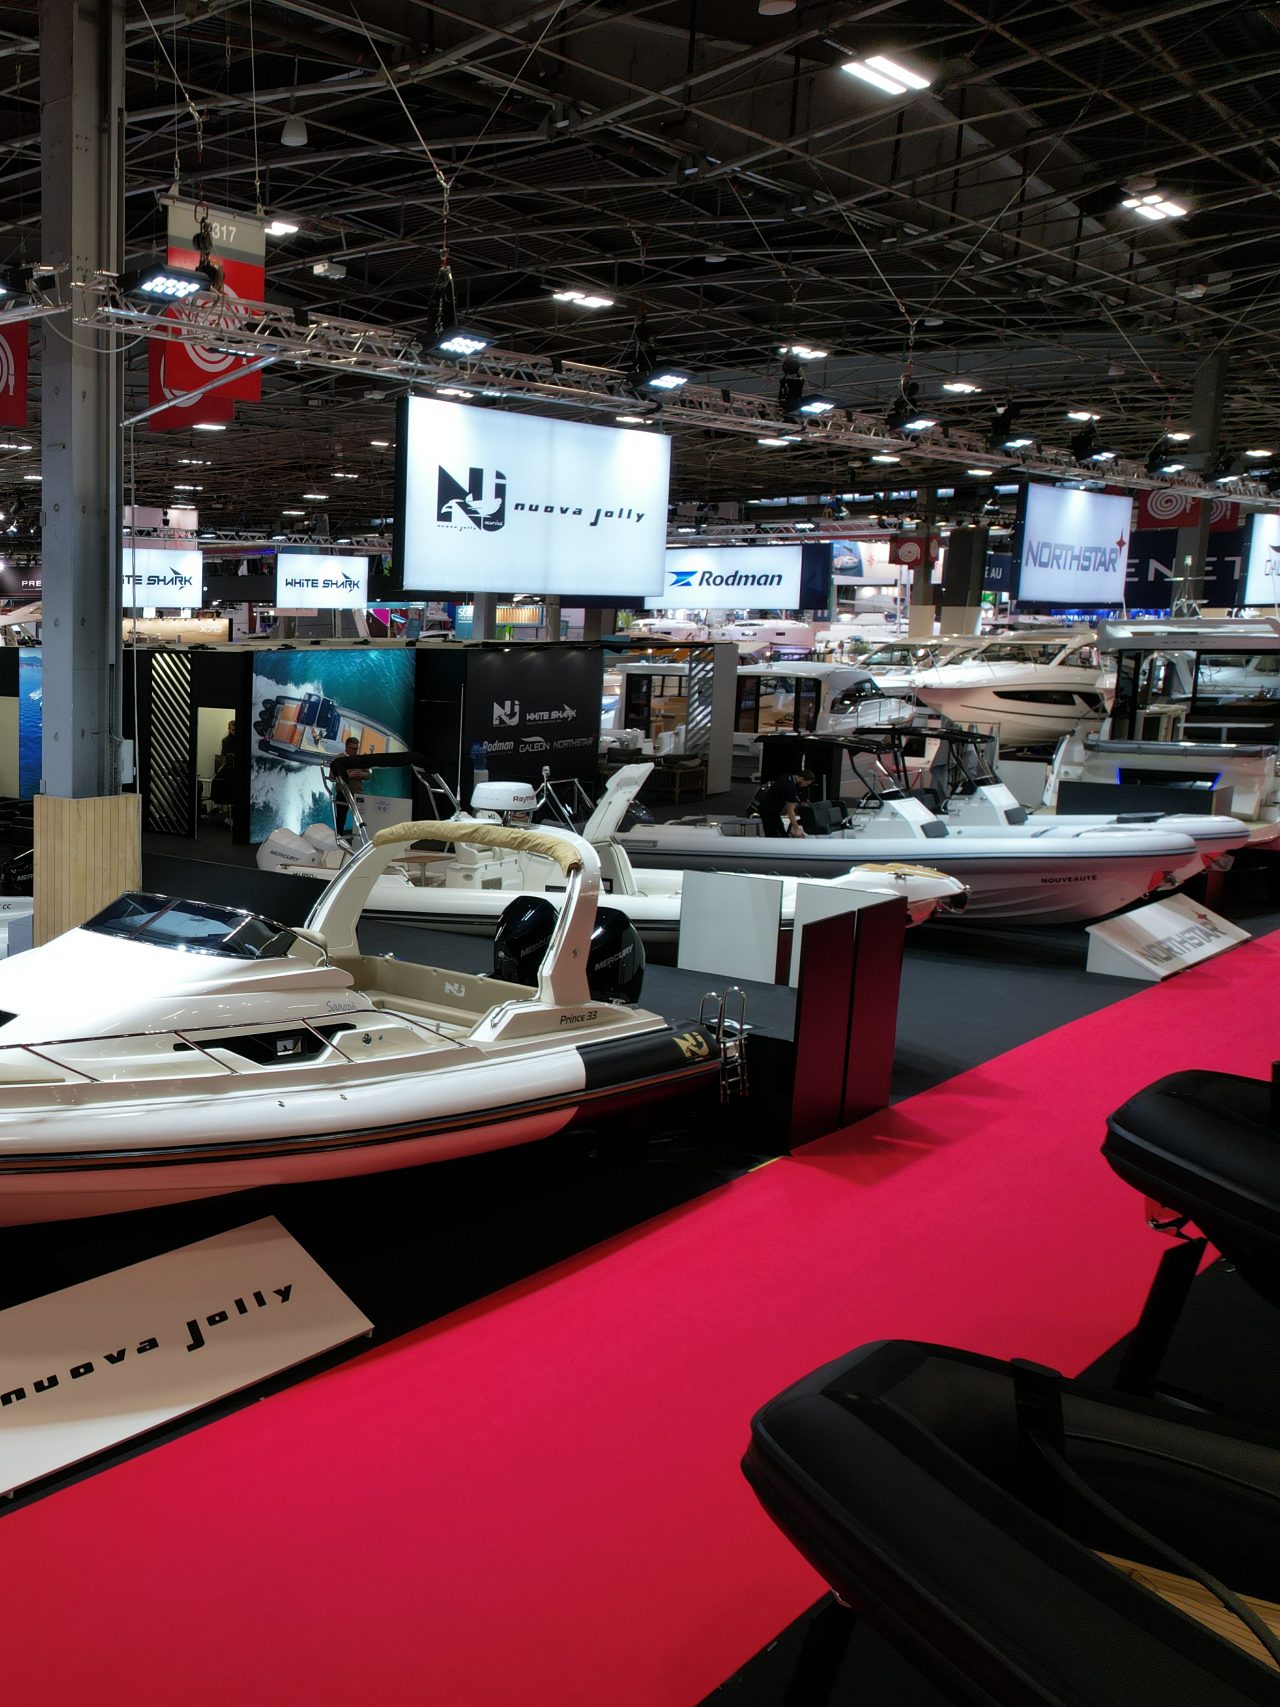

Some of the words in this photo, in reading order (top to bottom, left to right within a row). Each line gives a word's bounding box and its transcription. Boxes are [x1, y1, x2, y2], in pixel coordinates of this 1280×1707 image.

[210, 222, 237, 243] 317
[514, 502, 583, 516] nuova
[1024, 539, 1117, 573] NORTHSTAR
[146, 572, 192, 588] SHARK
[322, 576, 360, 590] SHARK
[698, 570, 783, 588] Rodman
[550, 706, 577, 722] SHARK
[482, 740, 514, 752] Rodman
[270, 849, 300, 862] MERCURY
[1135, 921, 1228, 967] NORTHSTAR
[594, 943, 634, 971] MERCURY
[559, 1012, 586, 1025] Prince
[585, 1010, 598, 1022] 33
[0, 1336, 160, 1407] nuova
